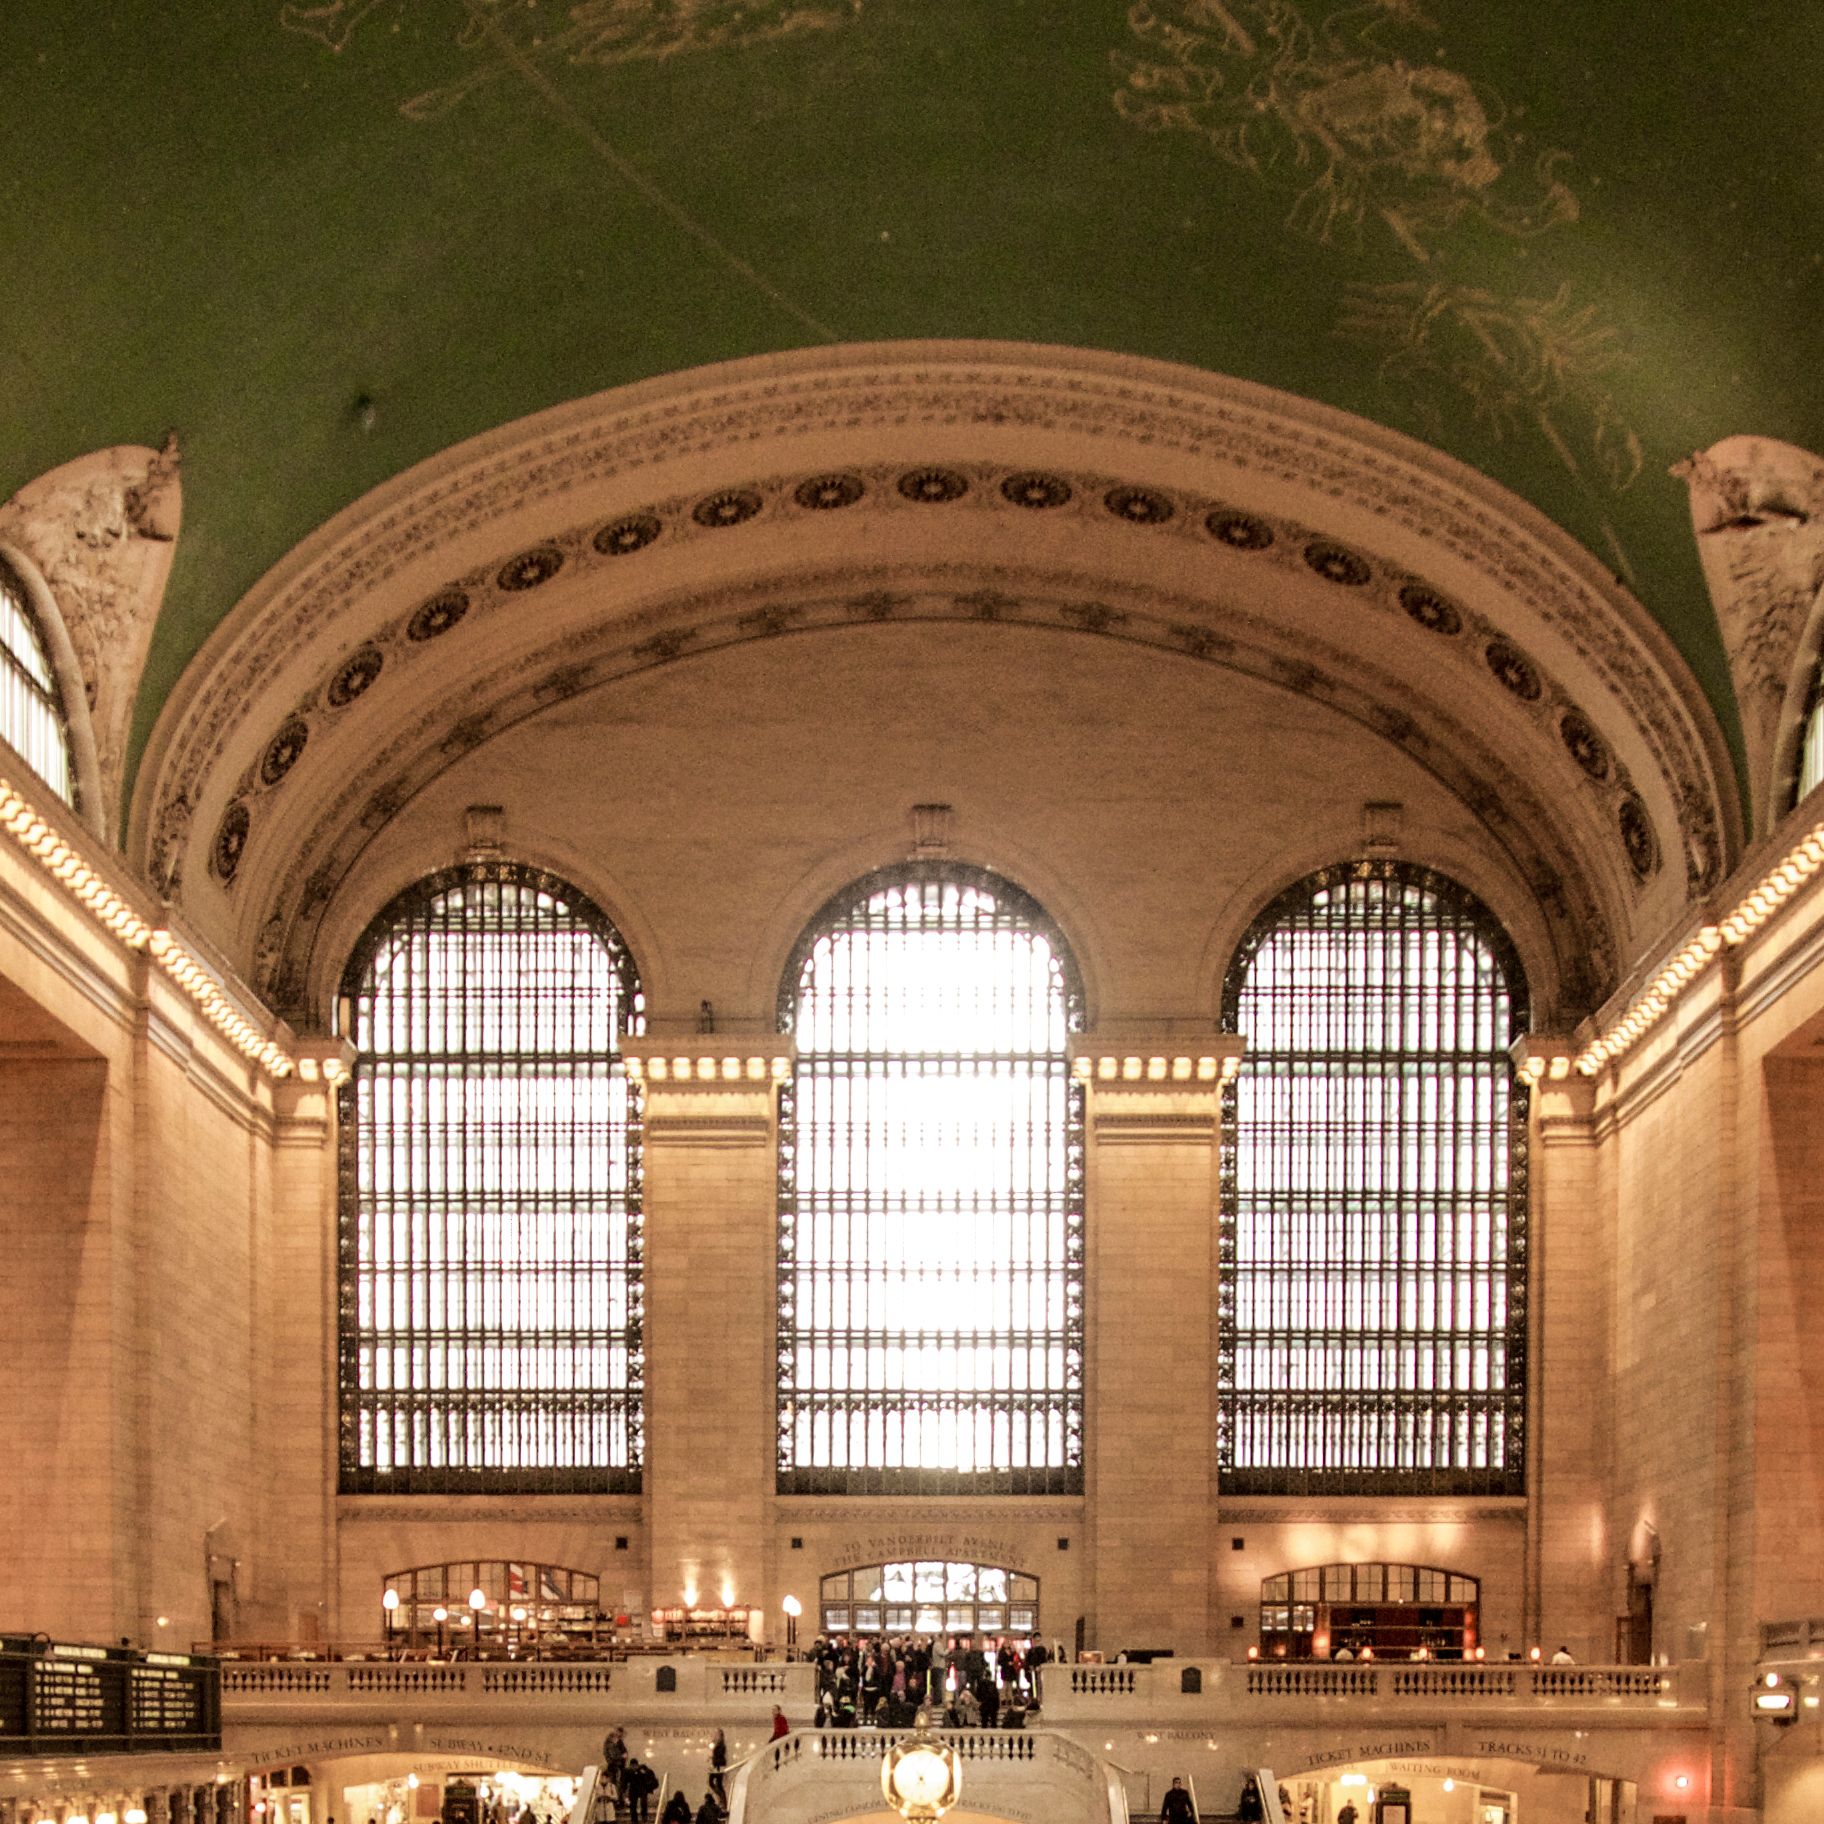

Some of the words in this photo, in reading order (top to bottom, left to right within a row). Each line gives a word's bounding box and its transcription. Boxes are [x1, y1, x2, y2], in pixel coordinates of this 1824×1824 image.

[307, 1736, 383, 1752] MACHINES
[1479, 1741, 1532, 1755] TRACKS
[1307, 1748, 1352, 1766] TICKET
[1360, 1741, 1430, 1756] MACHINES
